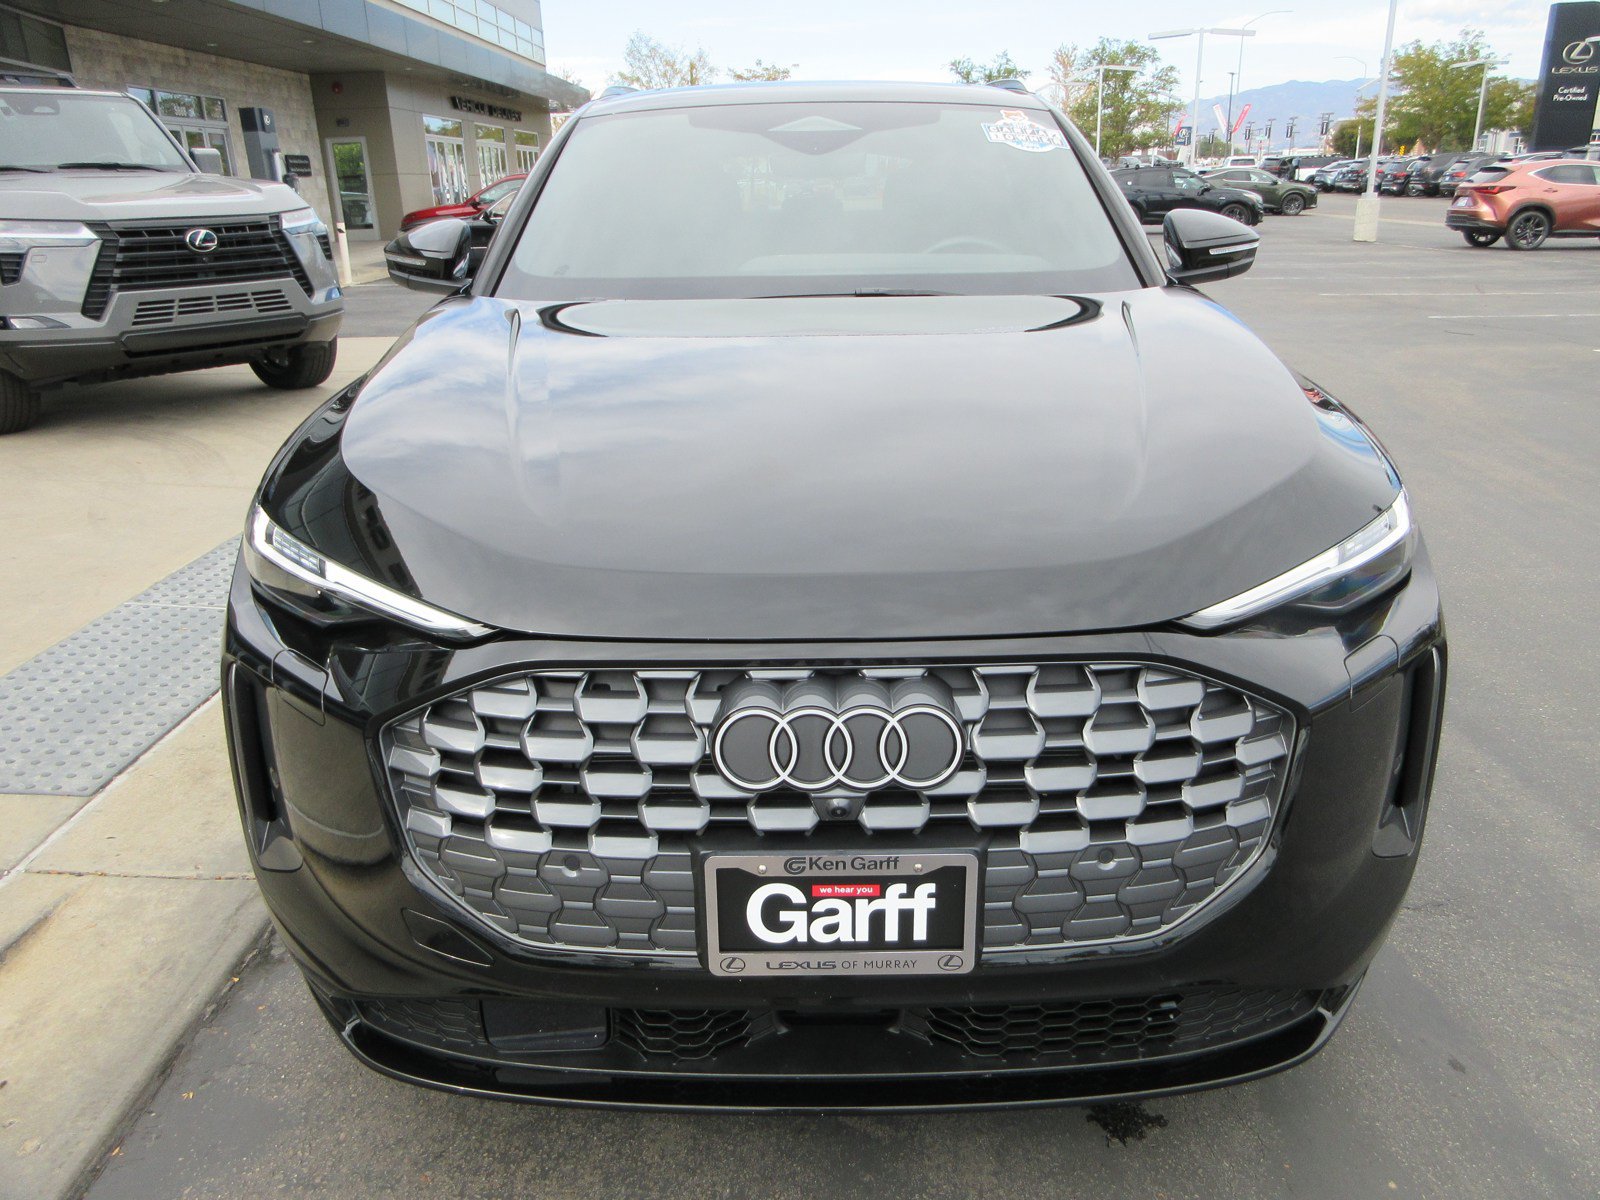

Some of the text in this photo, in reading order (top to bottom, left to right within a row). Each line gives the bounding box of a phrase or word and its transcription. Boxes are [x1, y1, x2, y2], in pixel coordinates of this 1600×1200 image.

[1551, 66, 1598, 74] LEXUS
[1558, 86, 1585, 94] Certified
[1553, 94, 1588, 102] Pre-Owned
[809, 856, 899, 871] Ken Garff
[834, 885, 854, 893] hear
[856, 887, 873, 895] you
[746, 882, 936, 944] Garff
[766, 959, 918, 970] LEXUS OF MURRAY
